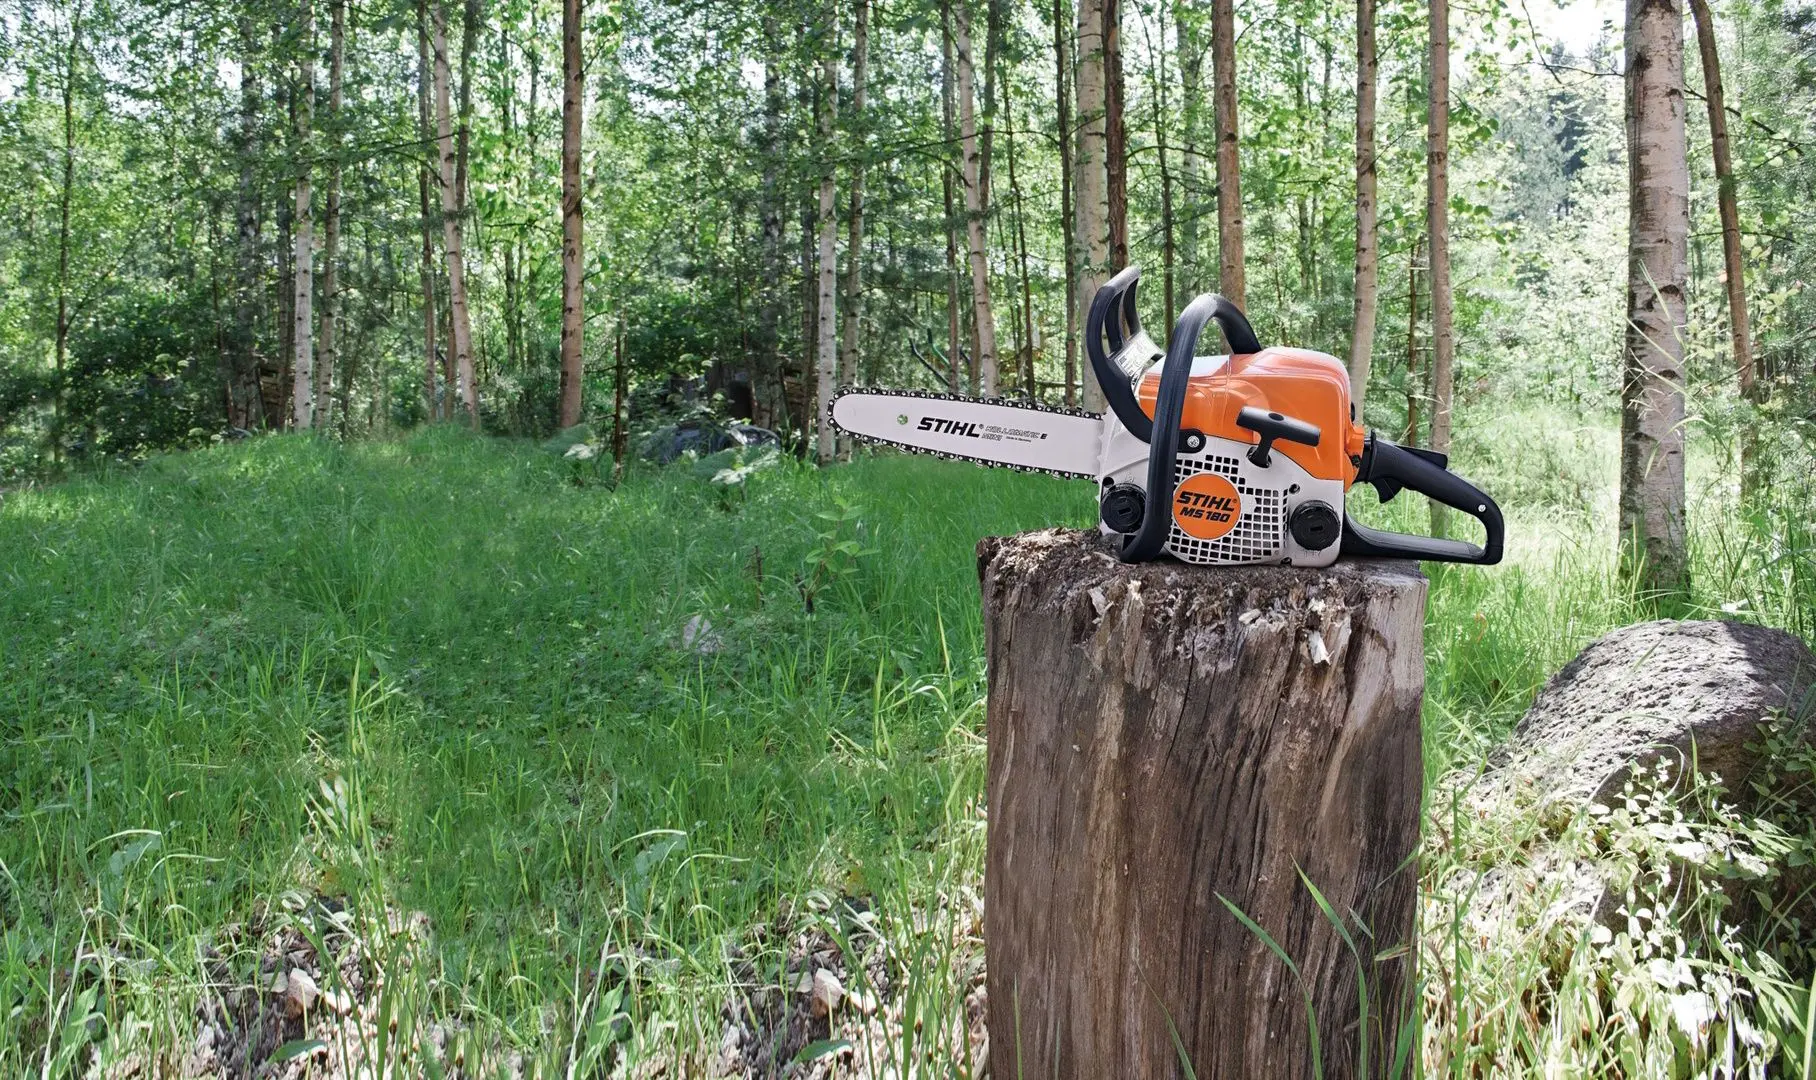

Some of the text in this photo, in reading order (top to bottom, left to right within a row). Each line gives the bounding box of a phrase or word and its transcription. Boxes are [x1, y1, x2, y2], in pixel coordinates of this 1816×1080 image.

[917, 417, 980, 438] STIHL
[1176, 491, 1235, 512] STIHL
[1180, 507, 1231, 523] MS 180
